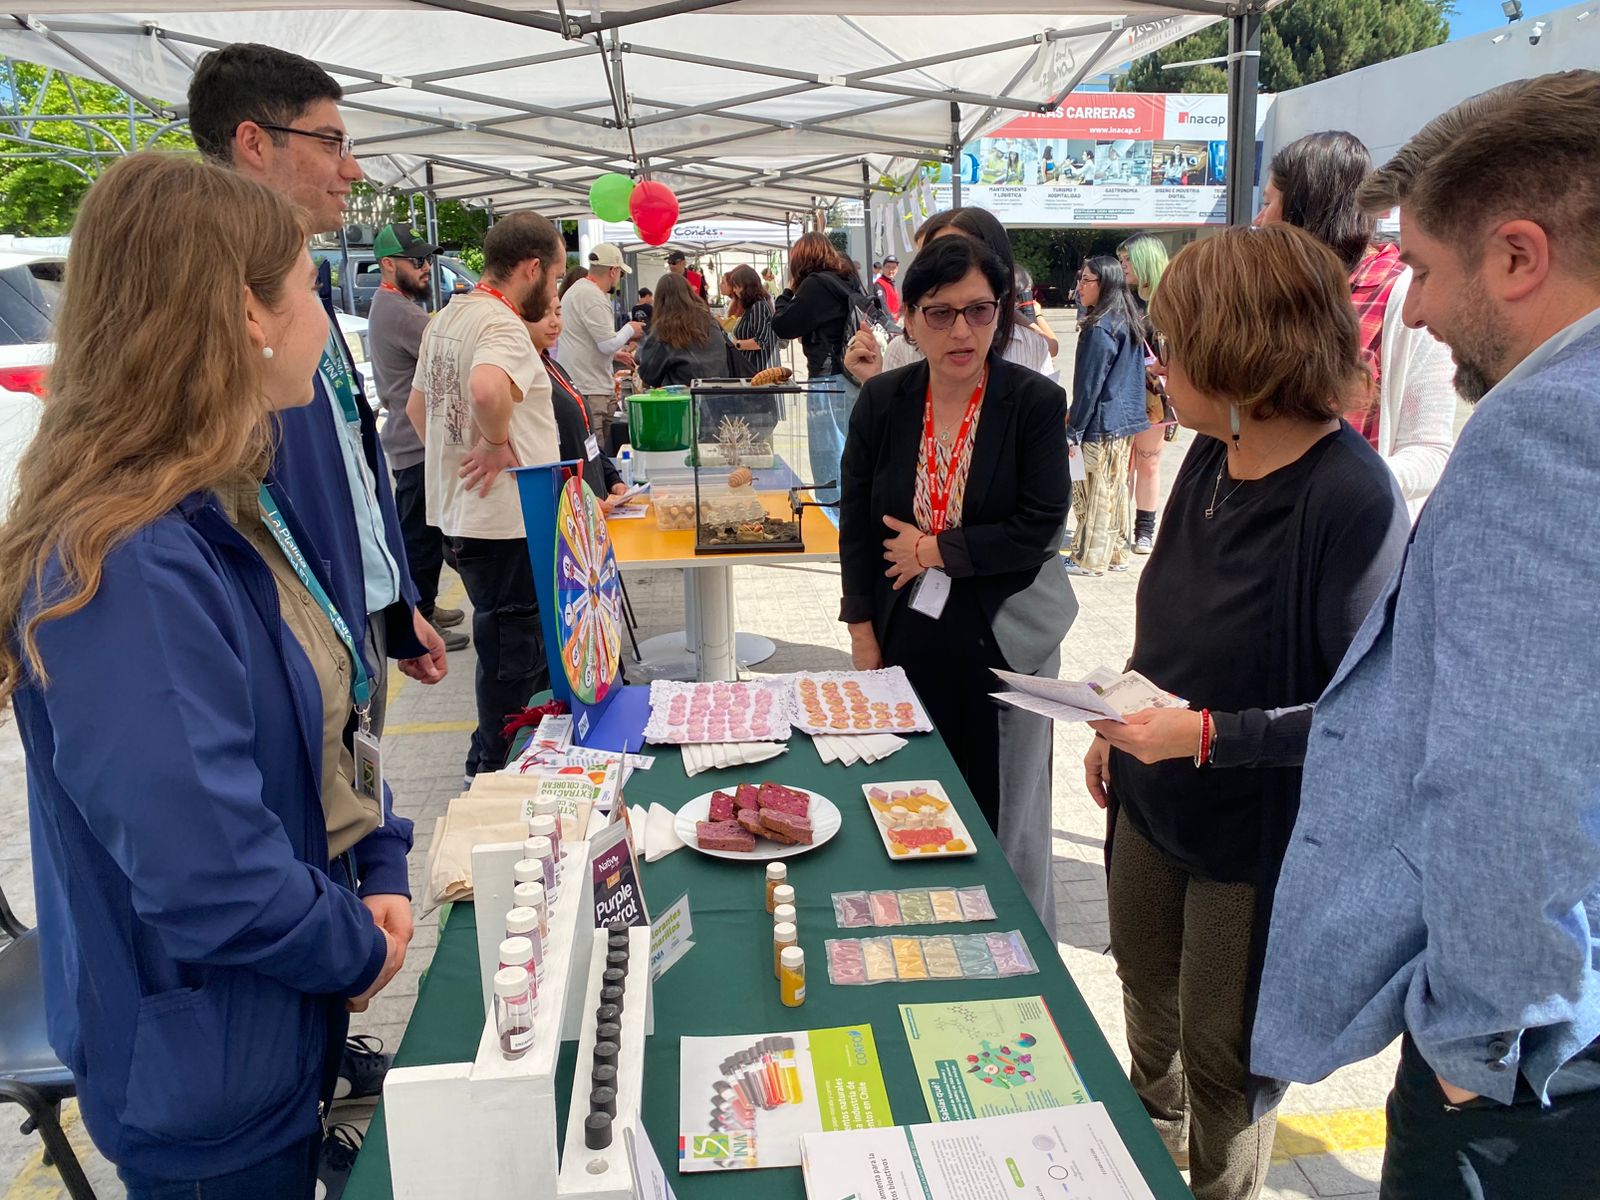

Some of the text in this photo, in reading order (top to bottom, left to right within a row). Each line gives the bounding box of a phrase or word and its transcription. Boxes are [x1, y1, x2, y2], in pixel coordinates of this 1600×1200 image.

[1066, 107, 1136, 120] CARRERAS
[1178, 111, 1226, 127] inacap
[1089, 126, 1141, 135] www.inacap.cl
[279, 528, 307, 569] Platina
[542, 781, 580, 790] COLOREAN
[596, 883, 633, 922] Purple
[651, 921, 681, 953] marillos
[851, 1035, 868, 1066] CORFO
[834, 1078, 847, 1110] naturales
[845, 1081, 855, 1090] de
[857, 1082, 869, 1100] Chile
[848, 1090, 862, 1122] industria
[862, 1100, 871, 1110] en
[868, 1152, 888, 1200] amienta para la
[880, 1158, 896, 1190] bioactivos
